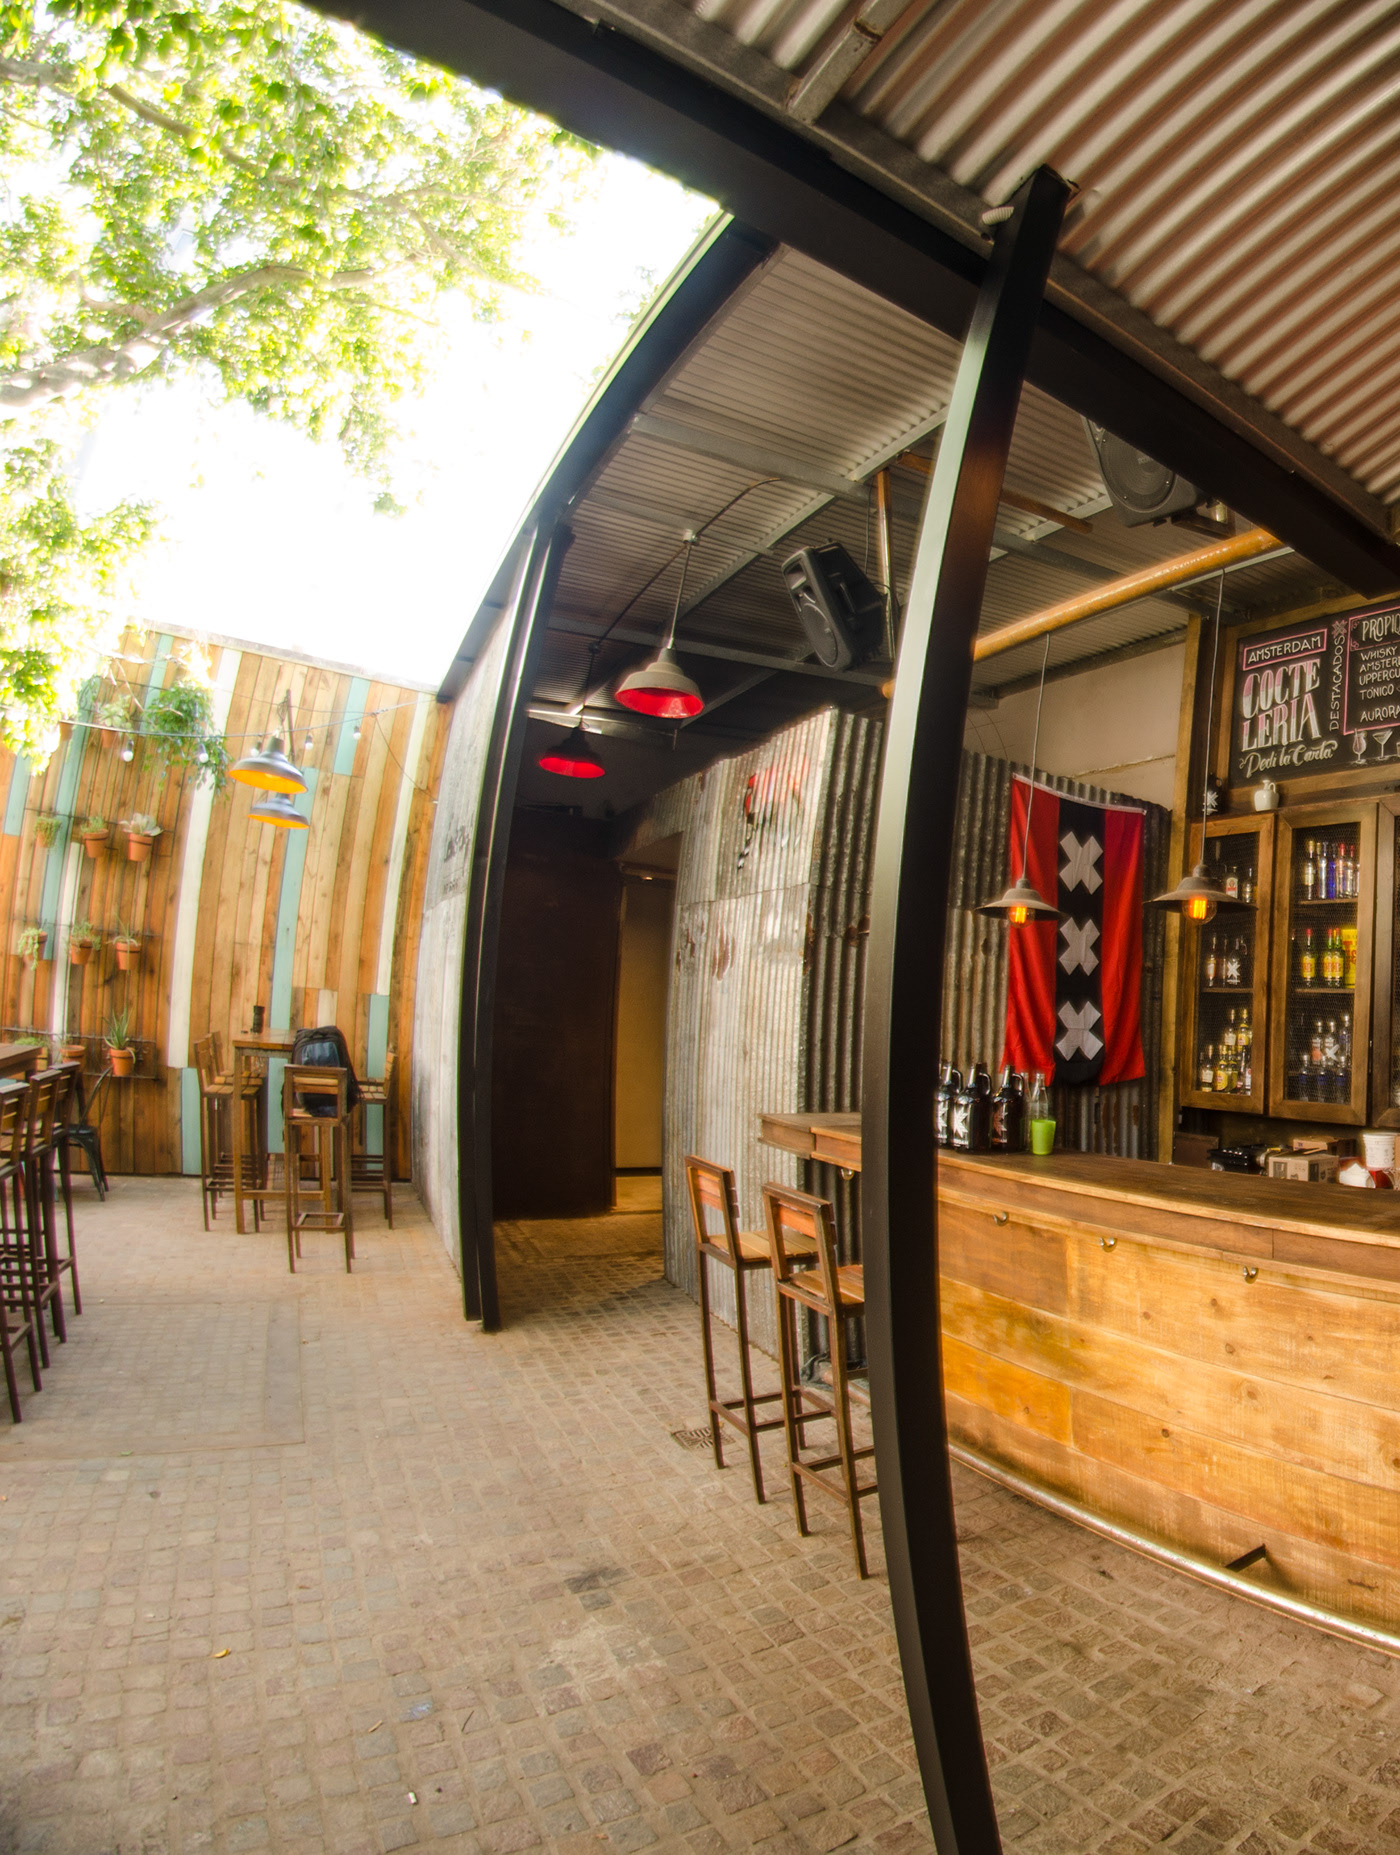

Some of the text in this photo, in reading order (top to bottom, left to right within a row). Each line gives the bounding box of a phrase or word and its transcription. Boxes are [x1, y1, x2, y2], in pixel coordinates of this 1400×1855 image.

[1248, 636, 1321, 664] AMSTERDAM
[1361, 646, 1397, 661] WHISKY
[1242, 658, 1320, 719] COCTE
[1329, 635, 1345, 732] DESTACADOS
[1241, 692, 1322, 752] LERIA
[1288, 740, 1338, 766] Carta
